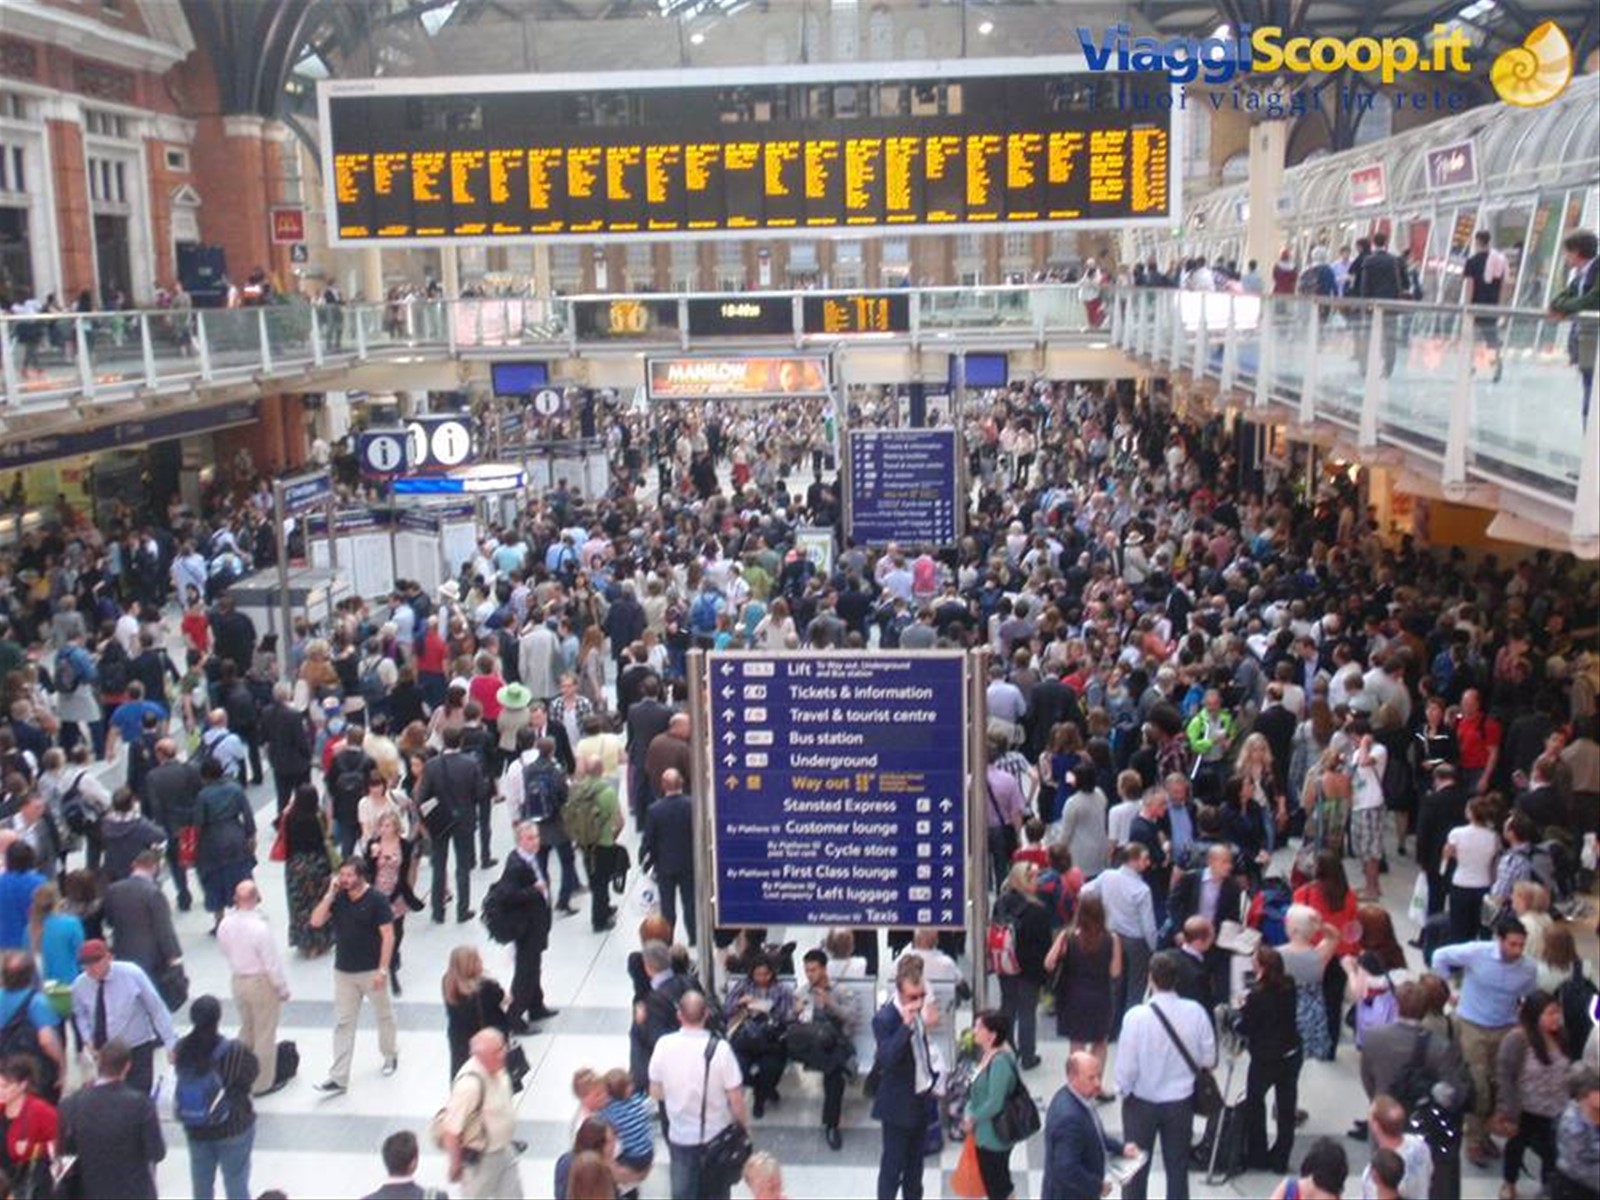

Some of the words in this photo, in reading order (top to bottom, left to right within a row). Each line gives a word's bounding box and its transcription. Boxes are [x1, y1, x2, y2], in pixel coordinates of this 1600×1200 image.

[668, 362, 748, 383] MANILOW
[788, 662, 811, 677] Lift
[861, 661, 911, 671] Underground
[789, 685, 837, 699] Tickets
[840, 685, 851, 699] &
[855, 685, 933, 699] information
[789, 707, 829, 722] Travel
[832, 708, 843, 722] &
[846, 708, 890, 722] tourist
[893, 709, 937, 723] centre
[789, 730, 814, 745] Bus
[817, 731, 863, 745] station
[790, 753, 878, 770] Underground
[791, 776, 823, 793] Way
[825, 777, 850, 791] out
[783, 798, 842, 812] Stansted
[845, 798, 897, 814] Express
[785, 820, 849, 834] Customer
[852, 820, 898, 837] lounge
[825, 842, 861, 858] Cycle
[864, 844, 898, 857] store
[783, 864, 812, 878] First
[816, 864, 849, 878] Class
[852, 865, 898, 881] lounge
[816, 886, 843, 900] Left
[846, 886, 898, 903] luggage
[866, 908, 898, 922] Taxis
